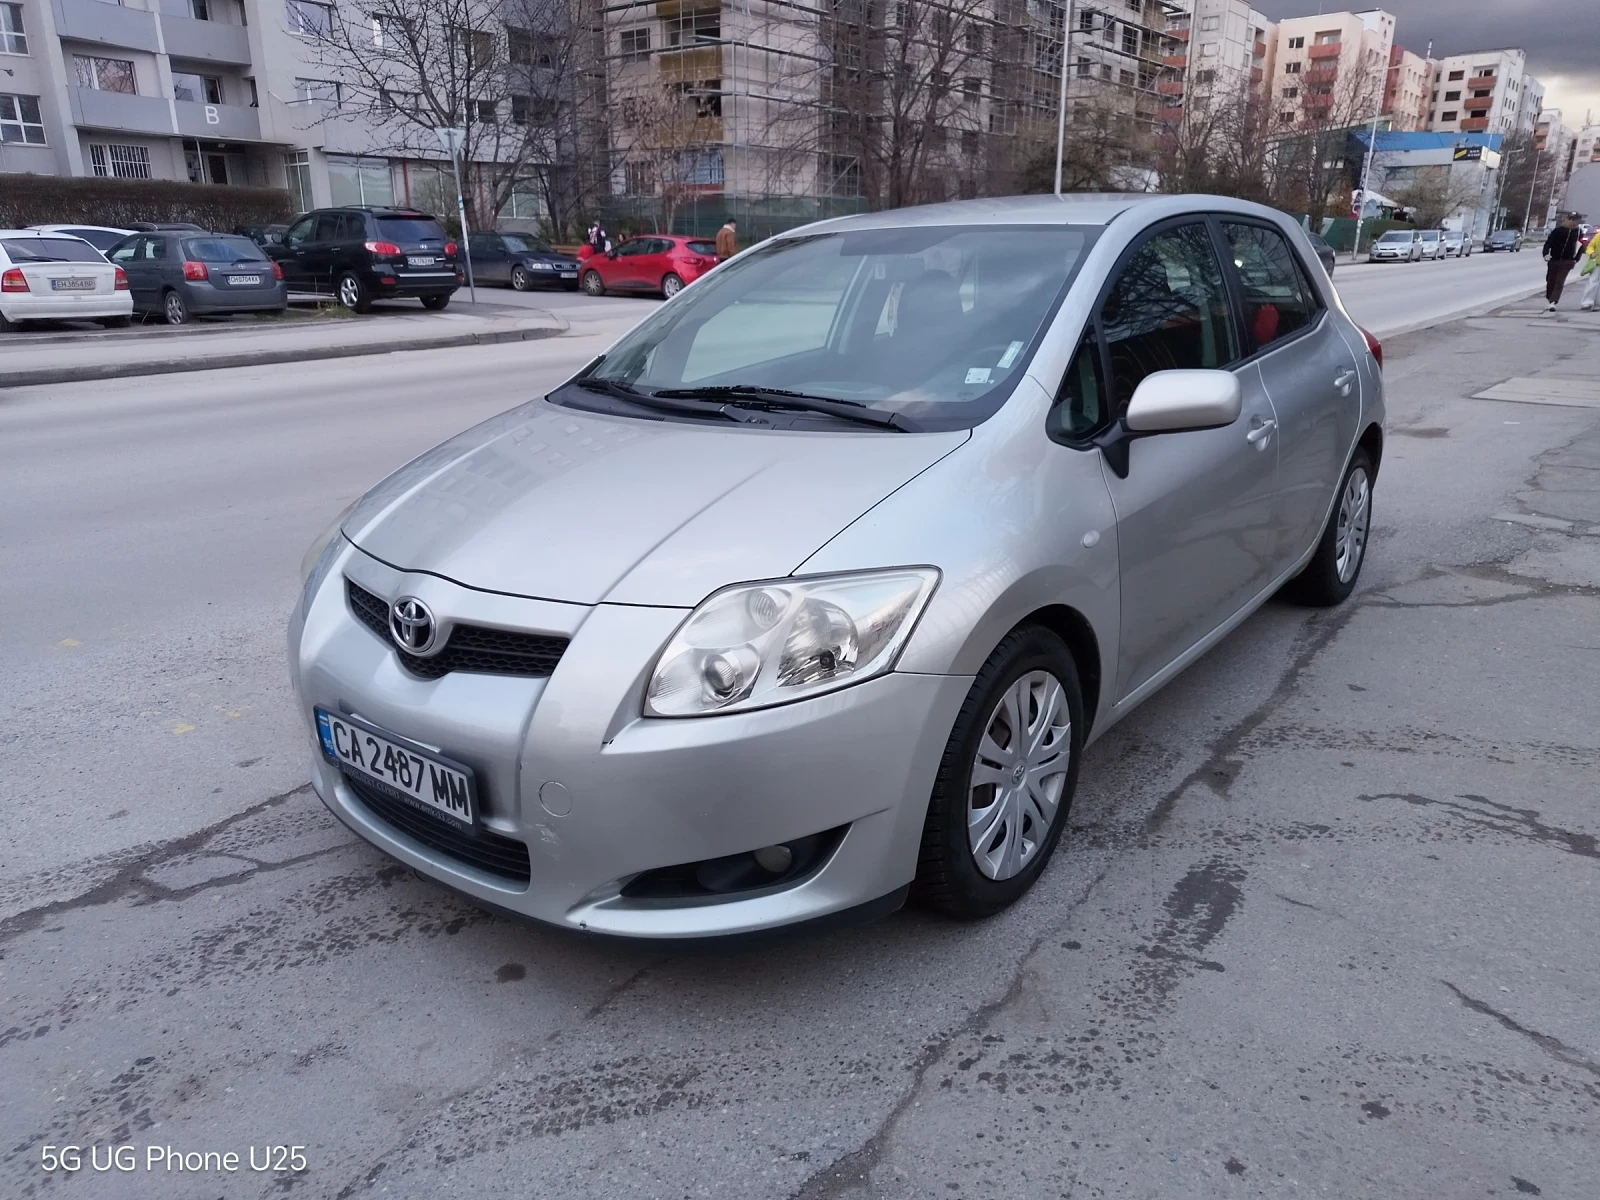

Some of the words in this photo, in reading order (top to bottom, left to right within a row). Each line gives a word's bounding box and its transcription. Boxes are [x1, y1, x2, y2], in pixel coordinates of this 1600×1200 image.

[333, 721, 365, 767] CA
[366, 736, 424, 793] 2487
[429, 763, 470, 817] MM
